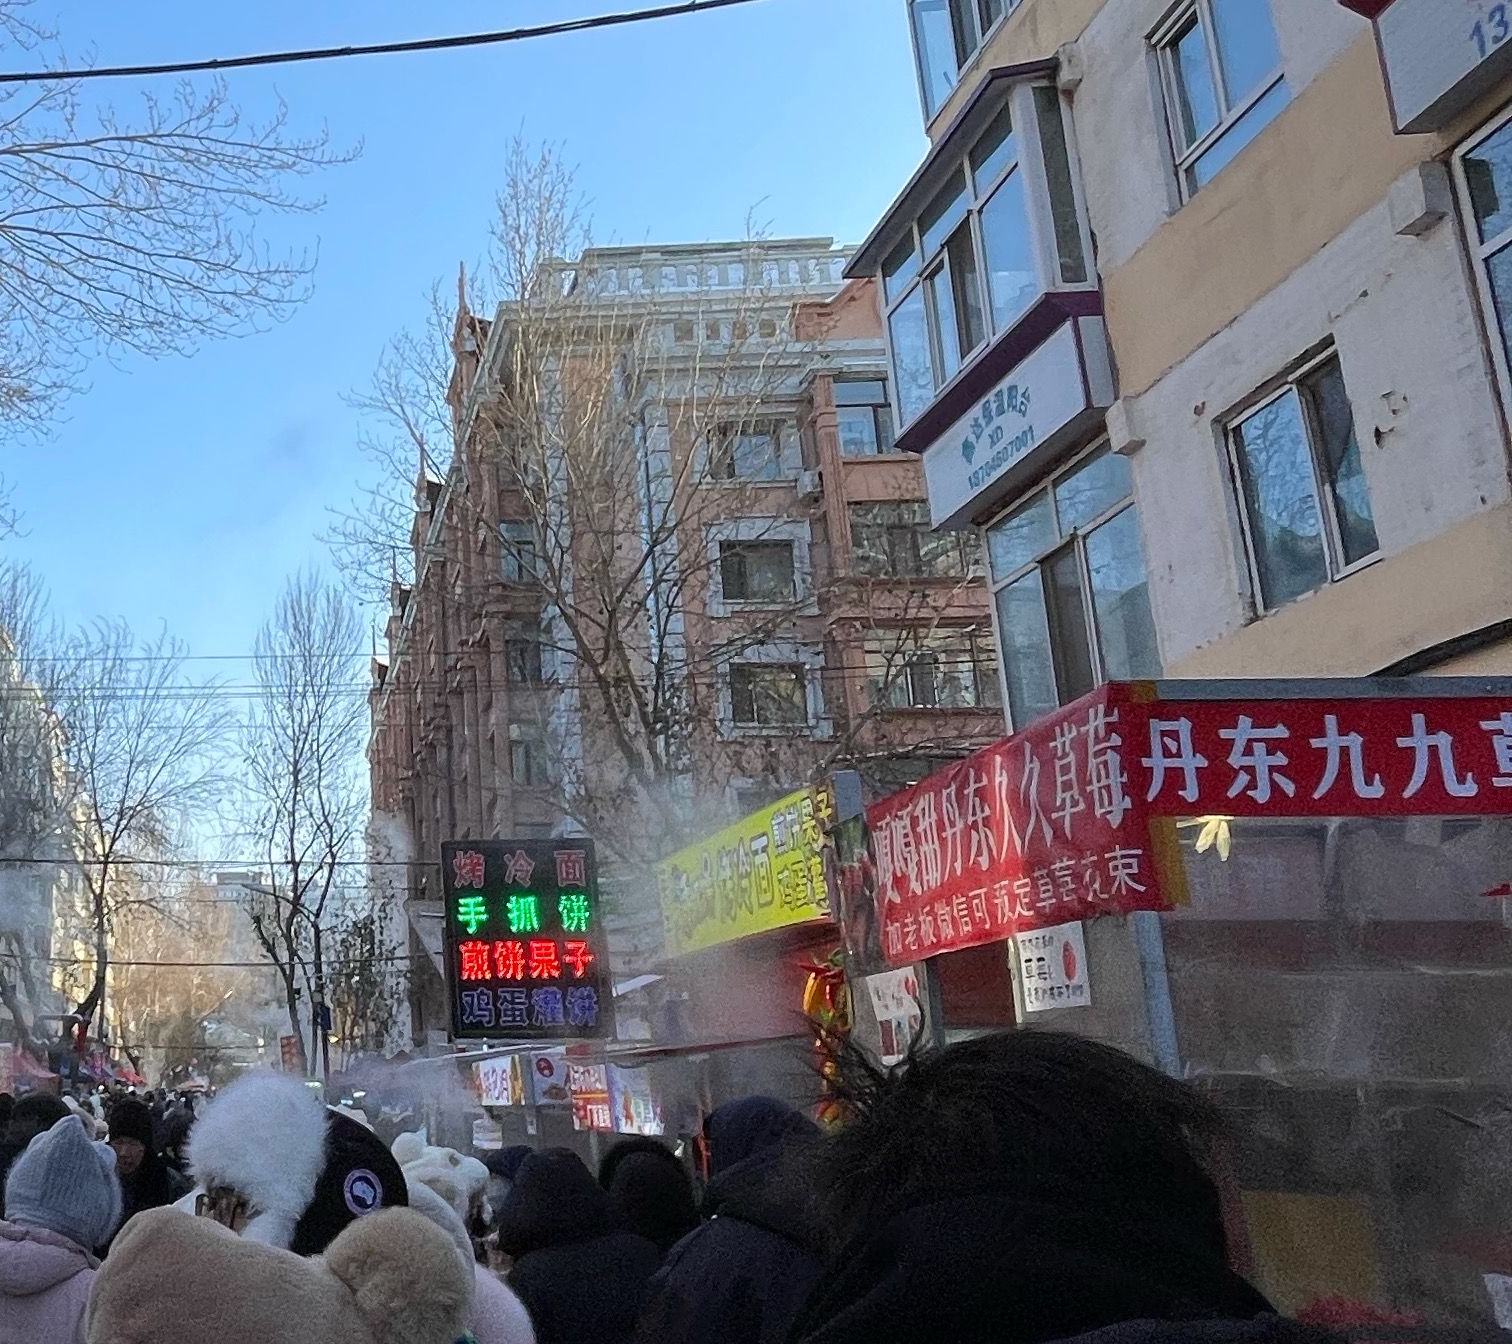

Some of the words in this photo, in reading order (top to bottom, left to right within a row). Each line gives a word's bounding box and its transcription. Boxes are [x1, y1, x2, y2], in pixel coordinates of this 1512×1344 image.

[453, 849, 587, 889] 烤冷面
[457, 894, 590, 935] 手抓饼
[459, 940, 594, 981] 煎饼果子
[462, 987, 599, 1027] 鸡蛋灌饼
